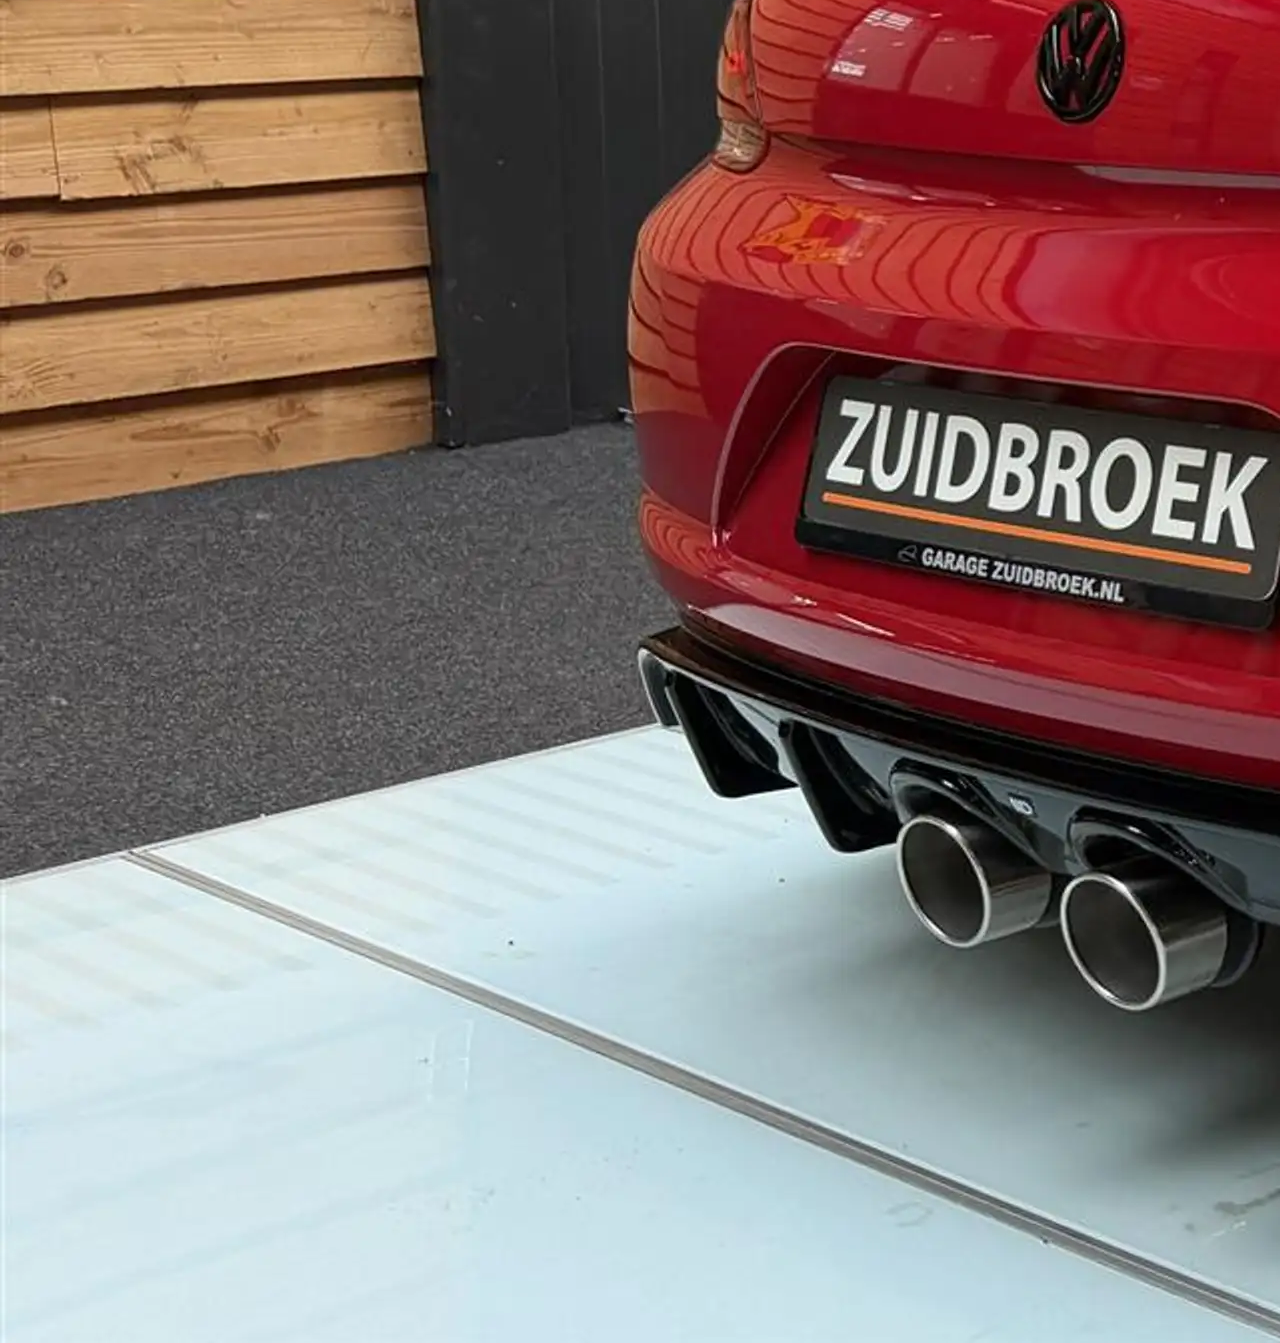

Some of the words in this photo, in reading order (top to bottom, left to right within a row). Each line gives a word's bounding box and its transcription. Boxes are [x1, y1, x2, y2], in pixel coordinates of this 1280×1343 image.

[826, 399, 1268, 550] ZUIDBROEK
[922, 548, 989, 577] GARAGE
[992, 560, 1125, 602] ZUIDBROEK.NL
